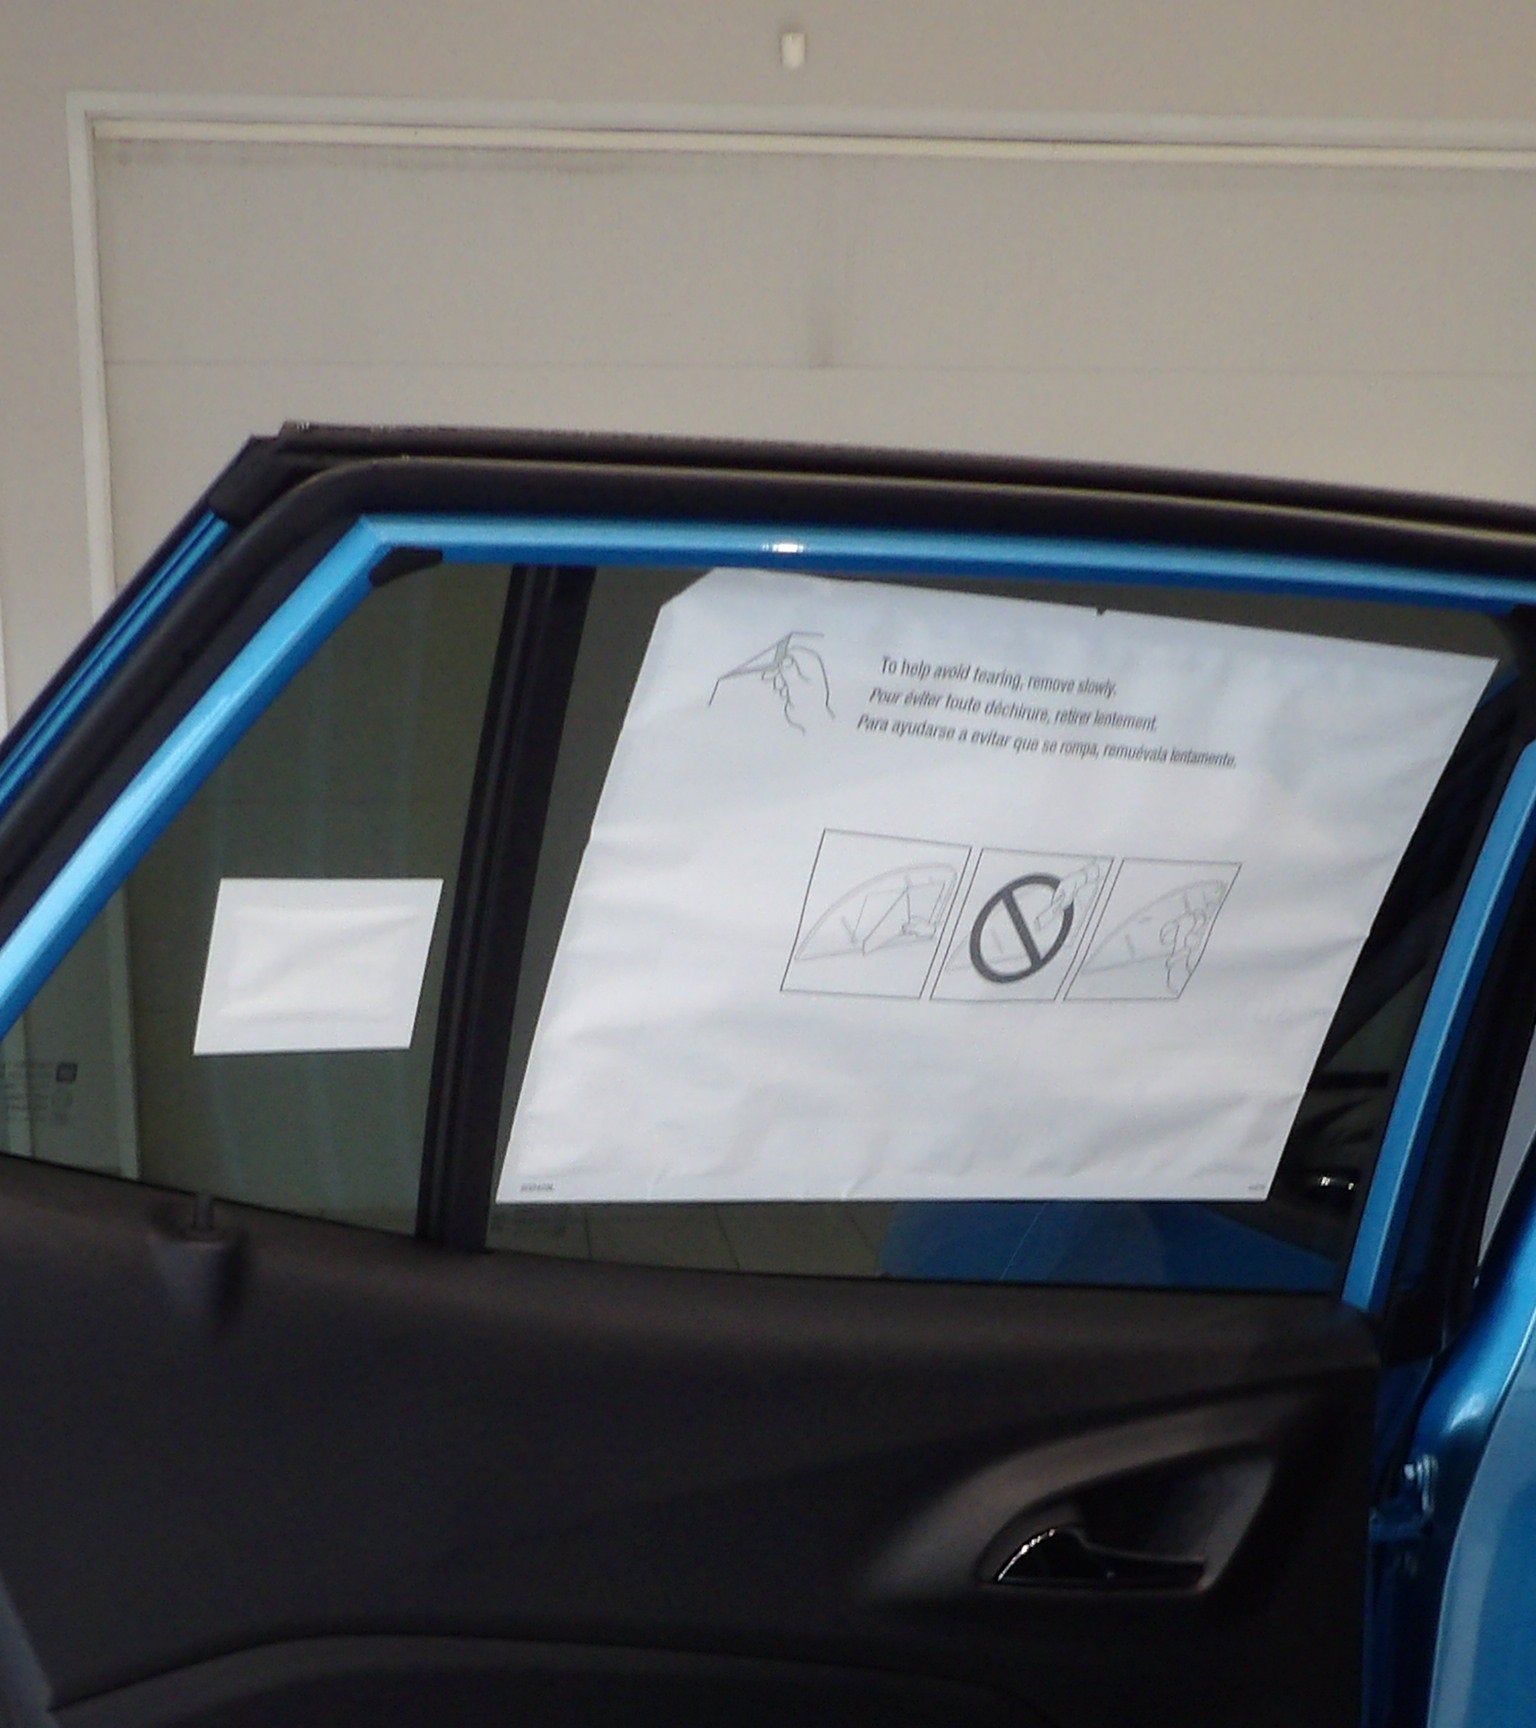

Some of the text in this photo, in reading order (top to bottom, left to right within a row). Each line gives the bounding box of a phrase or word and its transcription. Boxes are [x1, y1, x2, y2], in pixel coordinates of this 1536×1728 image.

[881, 655, 1117, 699] To help avoid tearing, remove slowly.
[869, 687, 1158, 733] Pour éviter toute déchirure, retirer lentement.
[857, 713, 889, 733] Para
[892, 719, 955, 742] ayudarse
[958, 728, 968, 742] a
[971, 729, 1011, 748] evitar
[1013, 736, 1039, 755] que
[1041, 739, 1057, 754] se
[1059, 740, 1099, 760] rompa,
